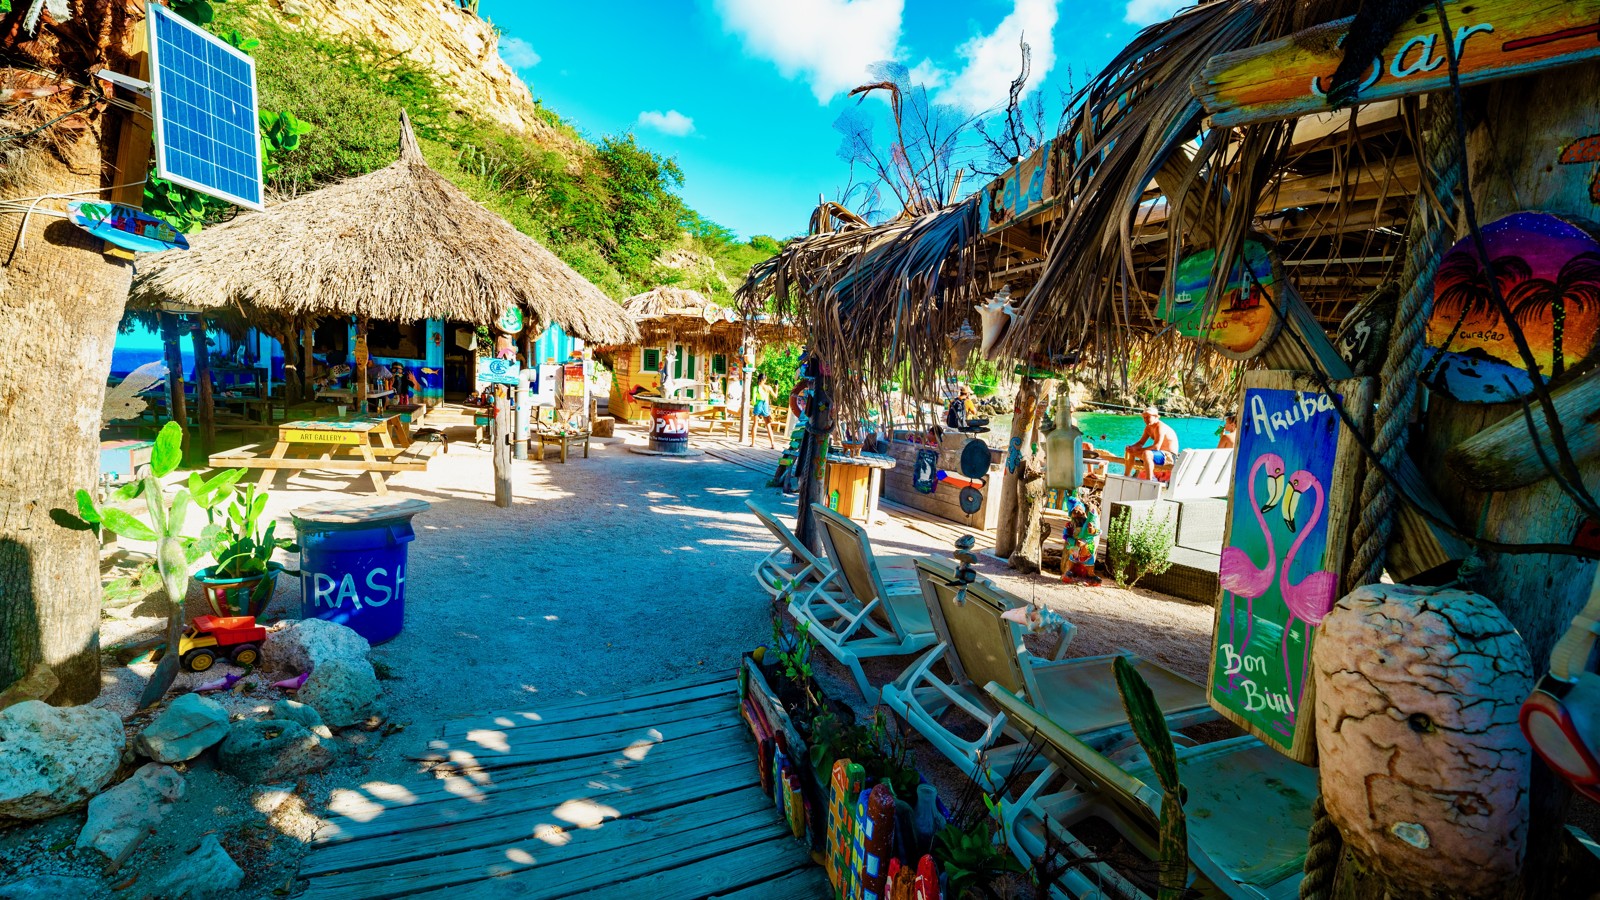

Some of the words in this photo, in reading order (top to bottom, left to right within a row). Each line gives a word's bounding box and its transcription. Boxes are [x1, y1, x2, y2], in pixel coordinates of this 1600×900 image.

[301, 564, 406, 610] TRASH
[1220, 643, 1267, 676] Bon
[1240, 680, 1295, 714] Bini
